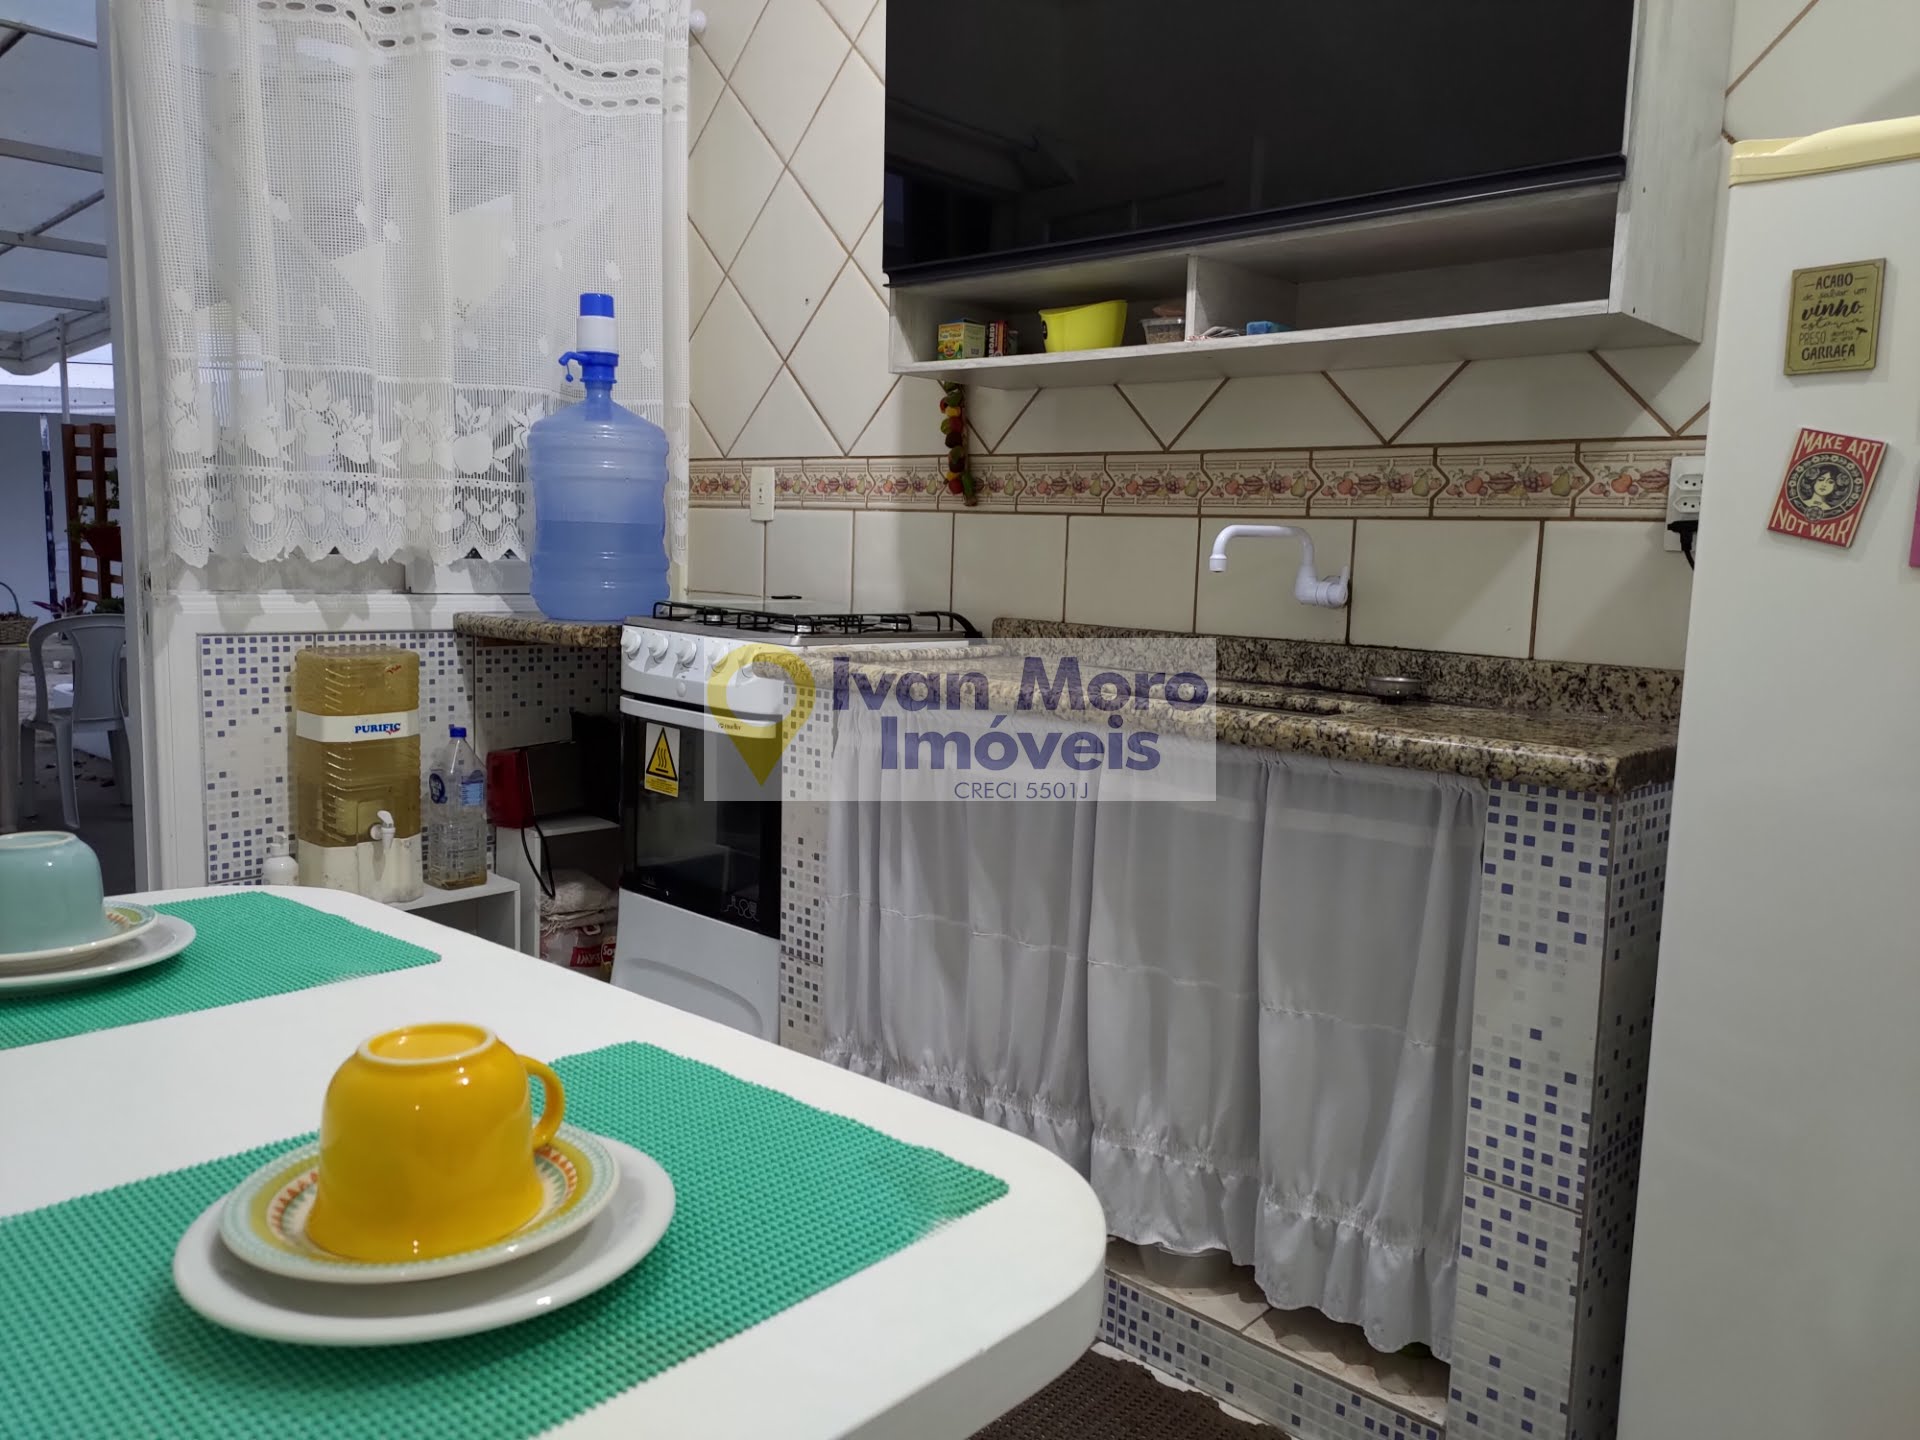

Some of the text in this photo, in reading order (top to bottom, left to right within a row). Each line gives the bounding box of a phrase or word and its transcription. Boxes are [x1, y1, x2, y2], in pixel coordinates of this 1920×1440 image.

[1815, 272, 1854, 290] ACABO
[1798, 331, 1827, 347] PRESO
[1801, 343, 1856, 361] GARRAFA
[1795, 430, 1882, 473] MAKE ART
[1771, 498, 1855, 545] NOT WAR
[354, 723, 402, 735] PURIFIC
